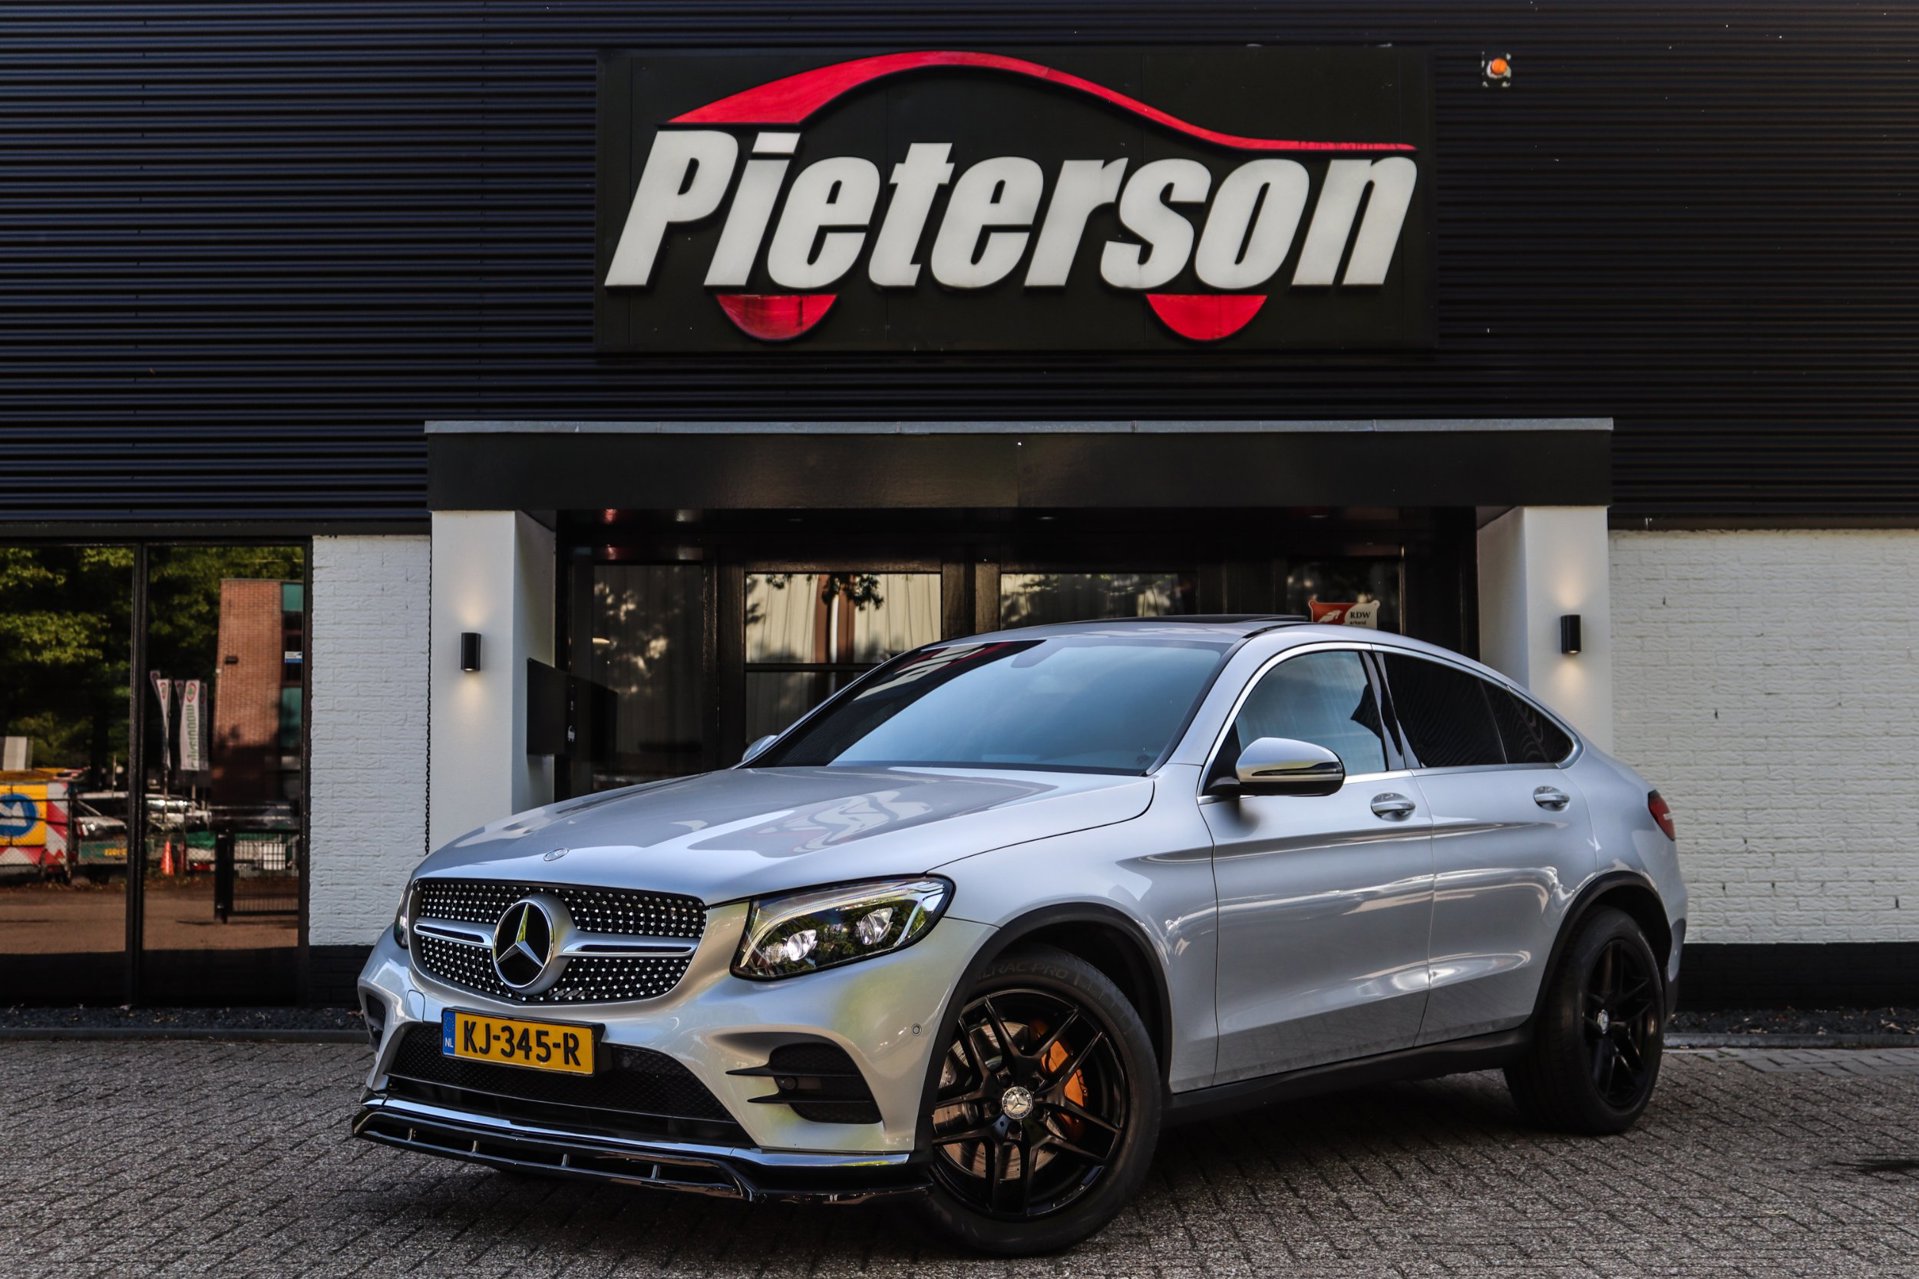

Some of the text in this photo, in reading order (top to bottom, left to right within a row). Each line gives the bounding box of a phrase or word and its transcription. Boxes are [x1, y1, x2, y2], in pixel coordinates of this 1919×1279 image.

[604, 130, 1418, 289] Pieterson
[1350, 611, 1371, 619] RDW
[444, 1020, 582, 1067] NL KJ-345-R
